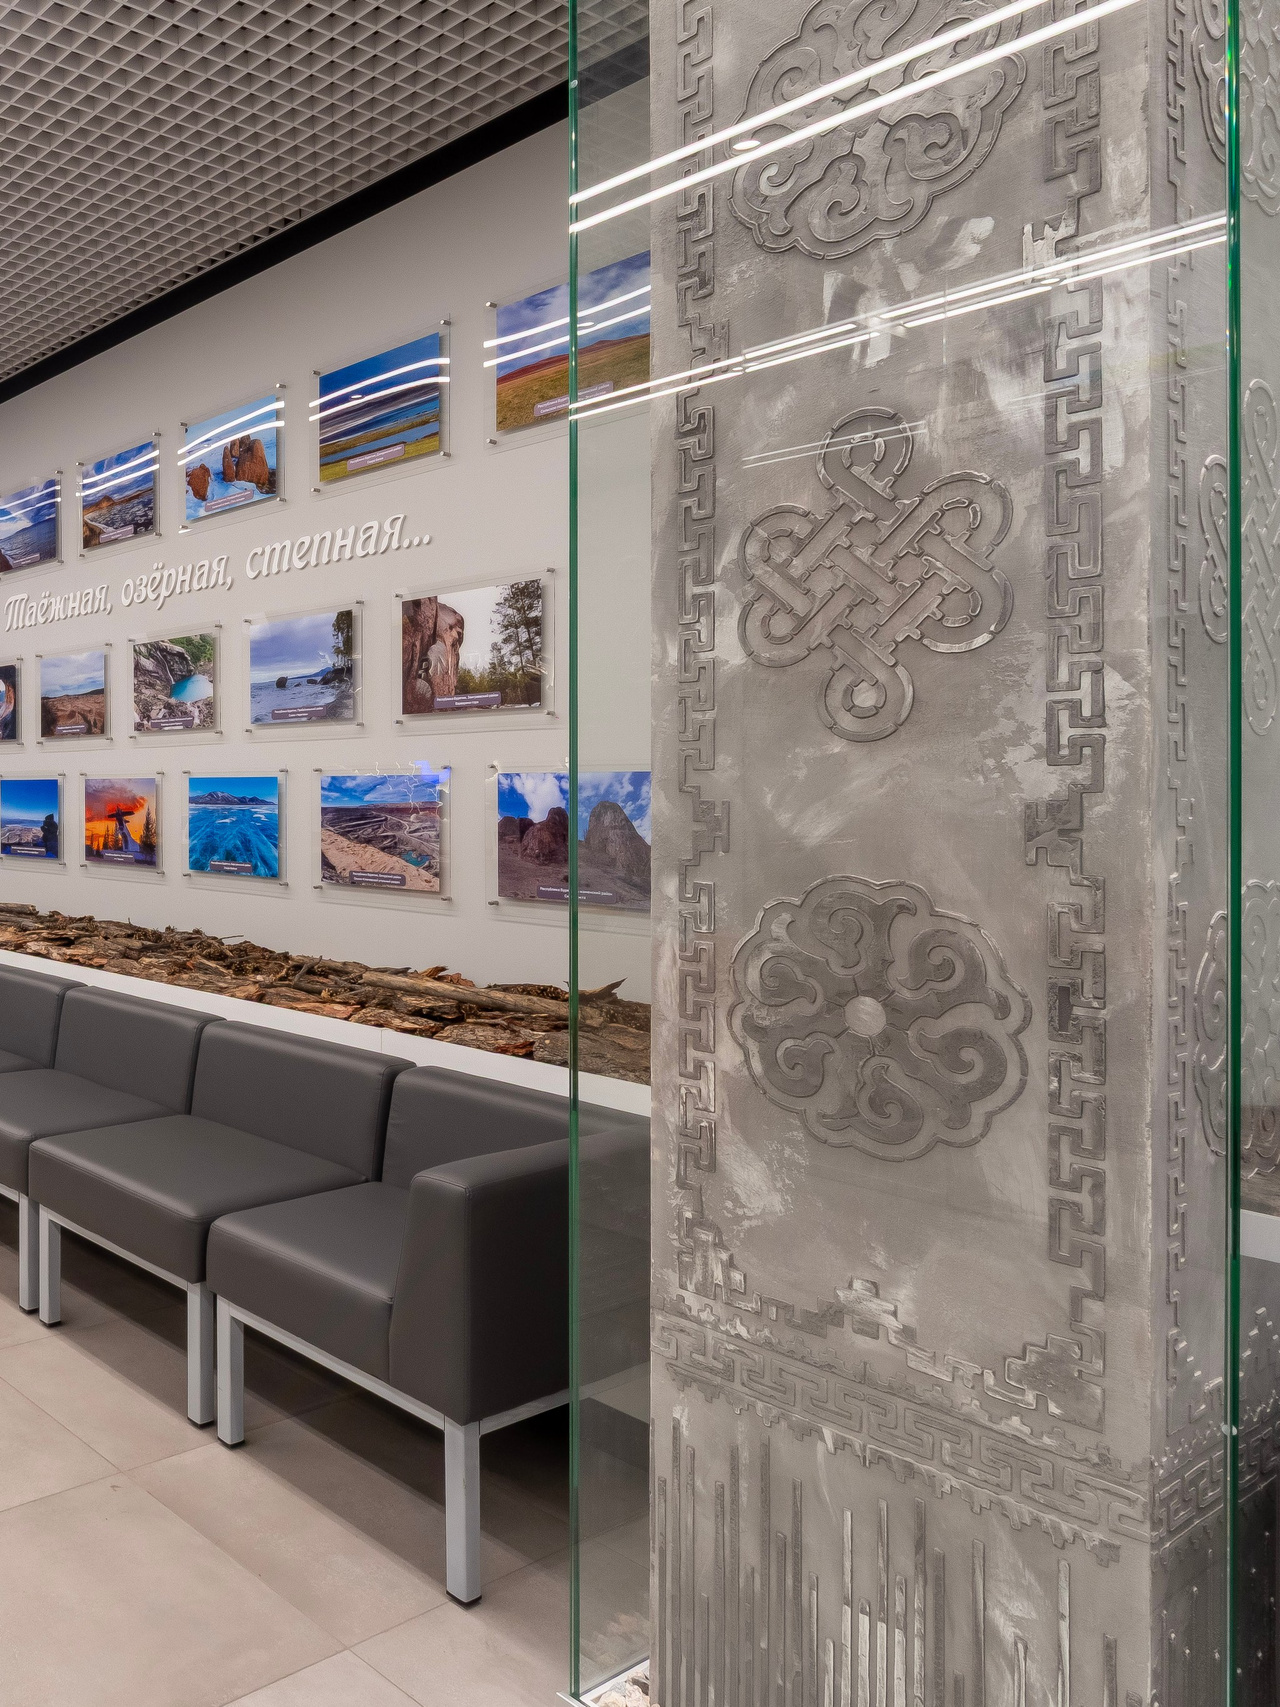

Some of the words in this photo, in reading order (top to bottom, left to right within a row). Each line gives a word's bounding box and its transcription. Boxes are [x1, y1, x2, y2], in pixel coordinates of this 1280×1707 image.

[4, 584, 113, 632] Таёжная,
[121, 555, 233, 611] озёрная,
[245, 513, 432, 580] степная...
